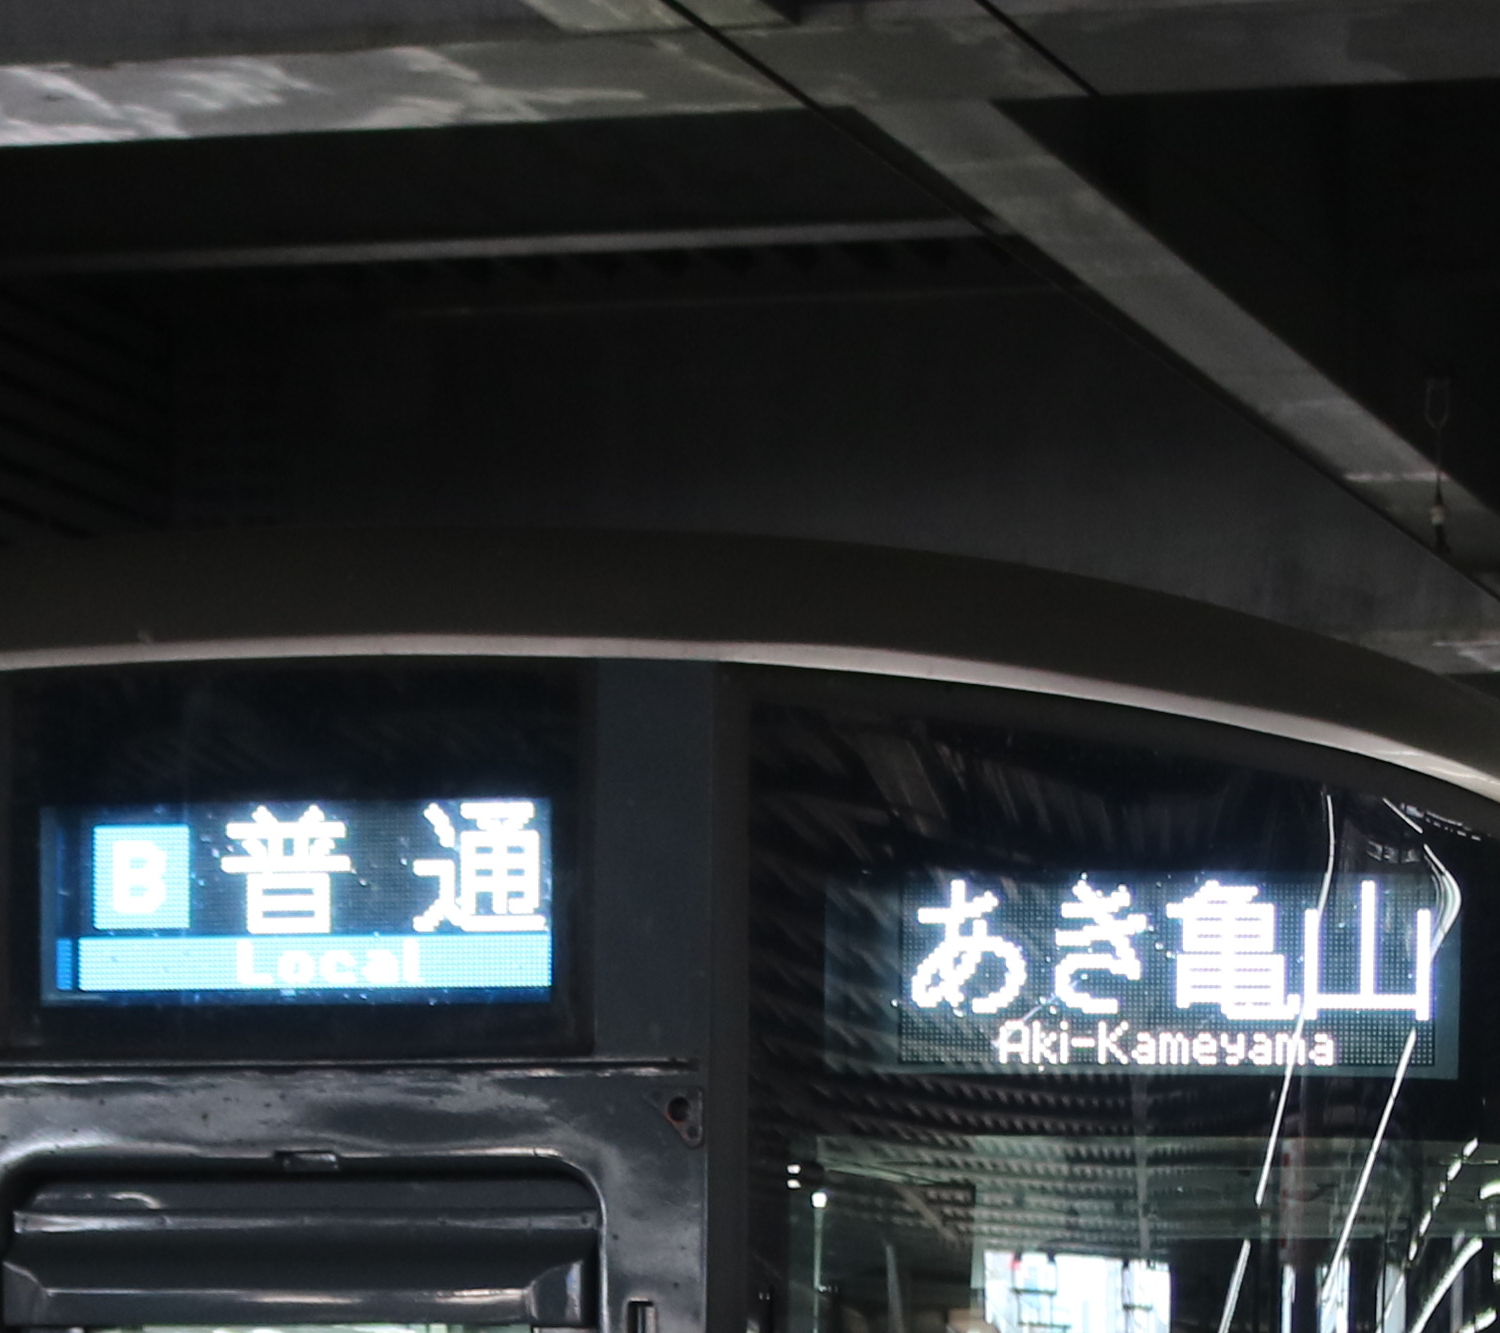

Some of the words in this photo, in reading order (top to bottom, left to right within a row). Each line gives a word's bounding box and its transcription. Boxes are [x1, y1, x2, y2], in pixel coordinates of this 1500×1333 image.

[111, 839, 168, 915] B
[220, 801, 549, 935] 普通
[235, 938, 425, 985] Local
[911, 879, 1432, 1021] あき亀山
[999, 1020, 1335, 1067] Aki-Kameyama
